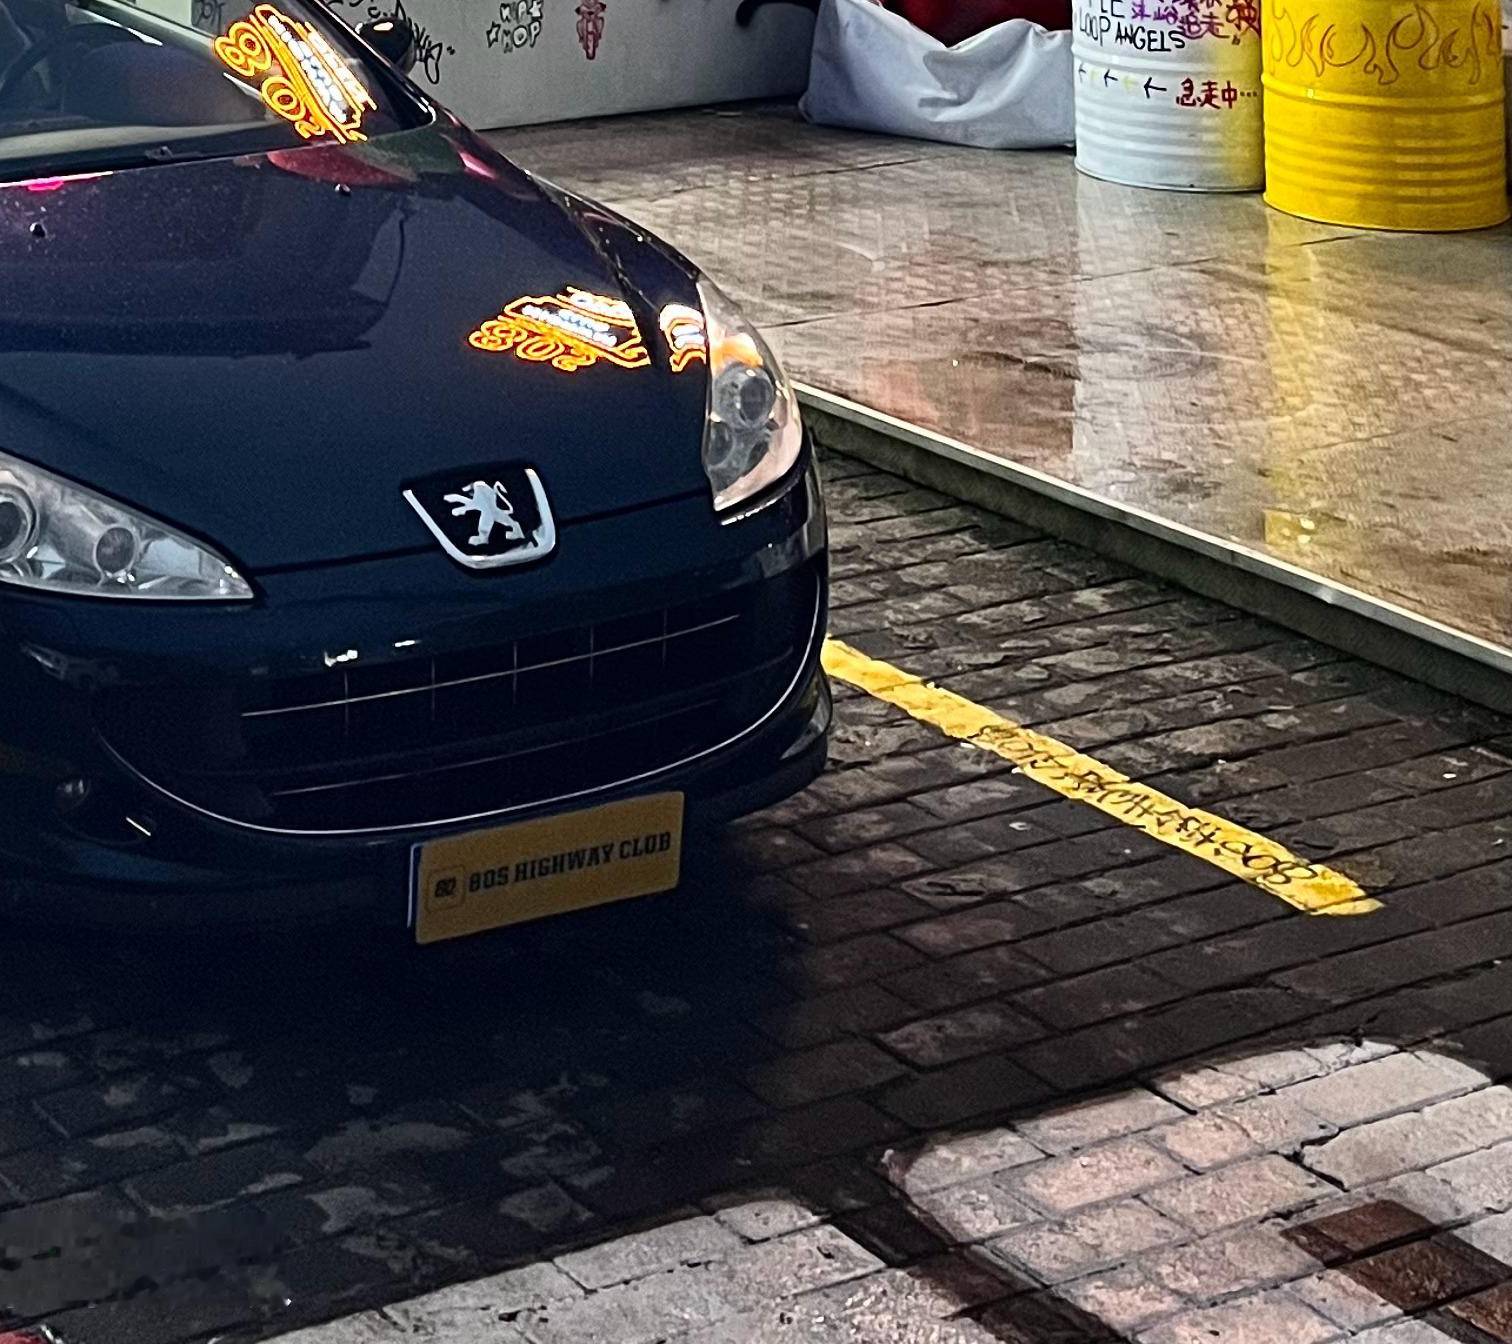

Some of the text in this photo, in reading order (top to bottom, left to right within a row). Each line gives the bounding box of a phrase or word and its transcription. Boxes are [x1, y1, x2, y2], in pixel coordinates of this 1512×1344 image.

[1115, 23, 1185, 52] ANGELS
[514, 843, 614, 882] HIGHWAY
[619, 832, 671, 860] CLUB
